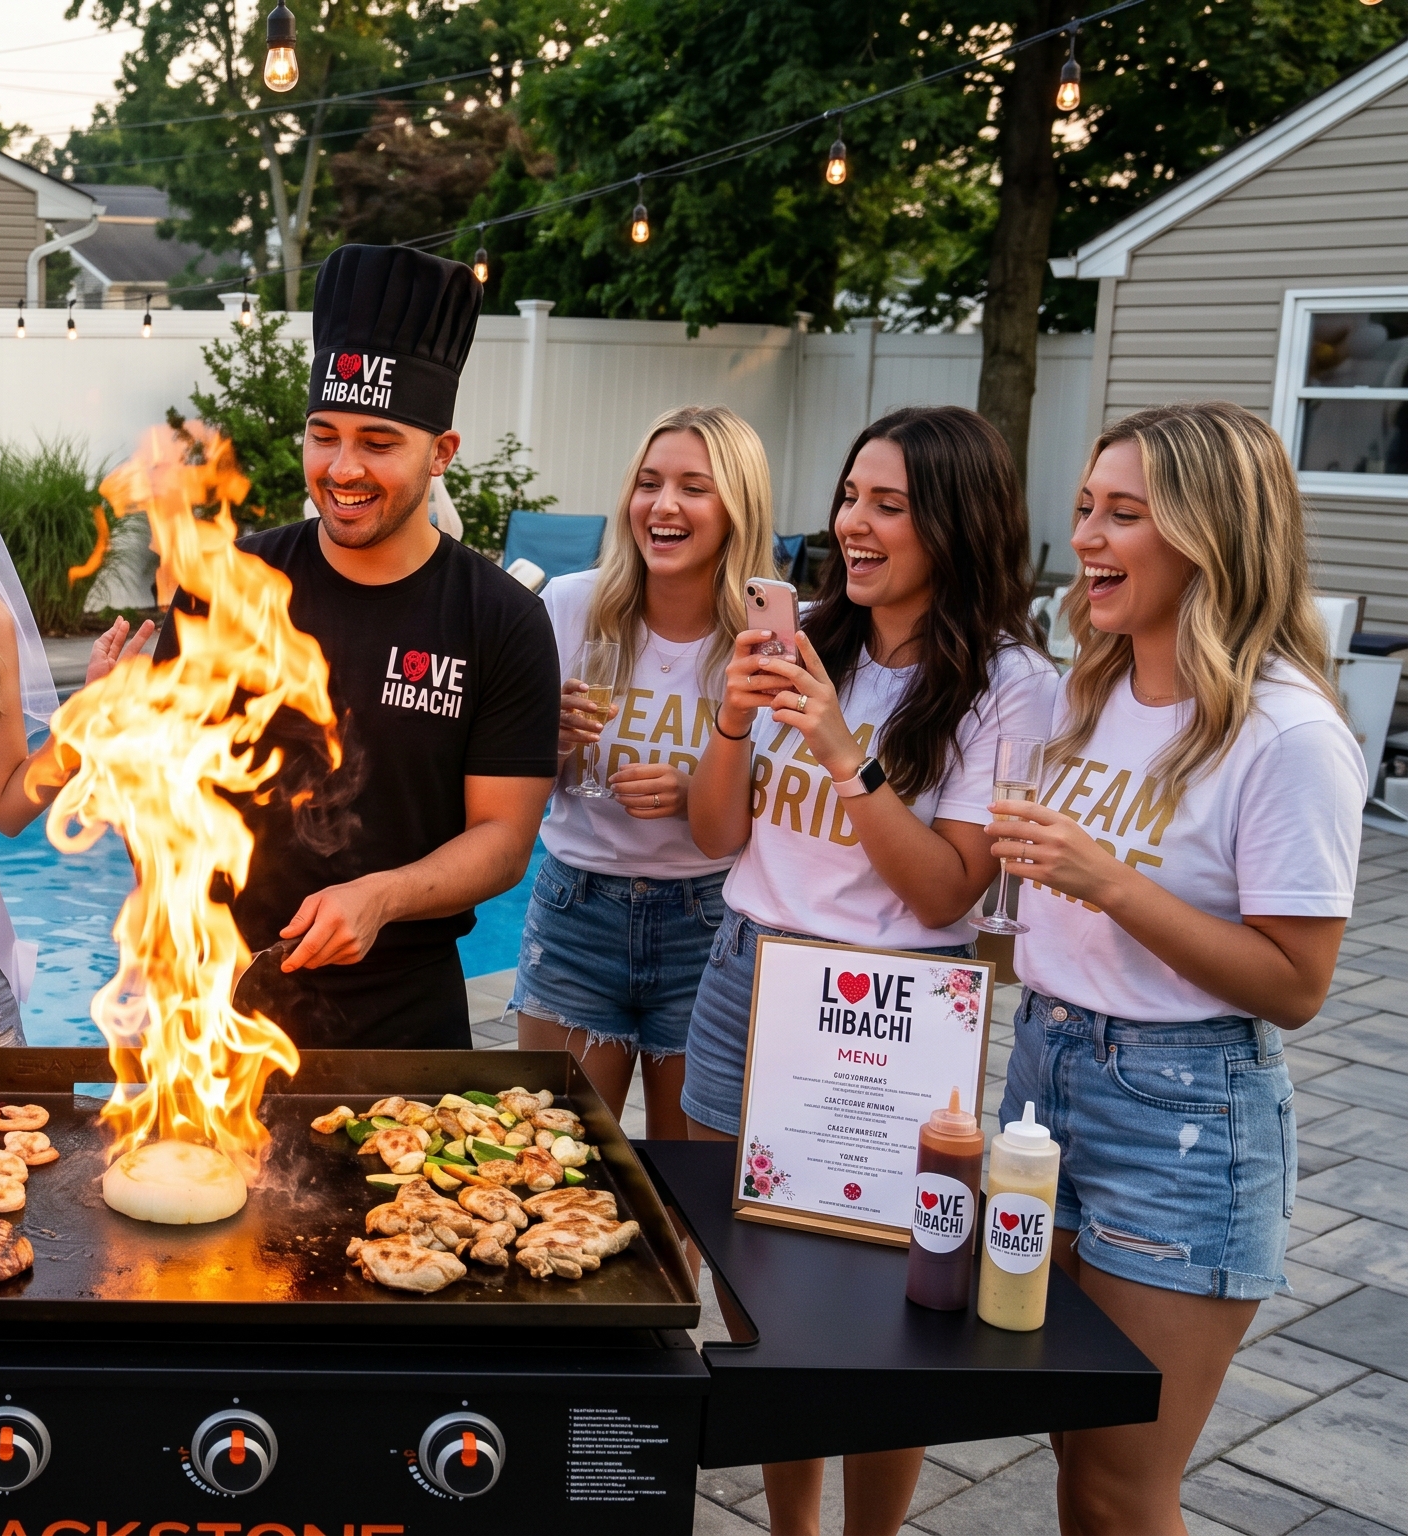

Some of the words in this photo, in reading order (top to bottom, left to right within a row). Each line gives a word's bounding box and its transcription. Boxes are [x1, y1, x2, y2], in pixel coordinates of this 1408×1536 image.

[321, 381, 392, 410] HIBACHI
[380, 681, 463, 719] HIBACHI
[818, 1006, 913, 1043] HIBACHI
[837, 1048, 888, 1067] MENU
